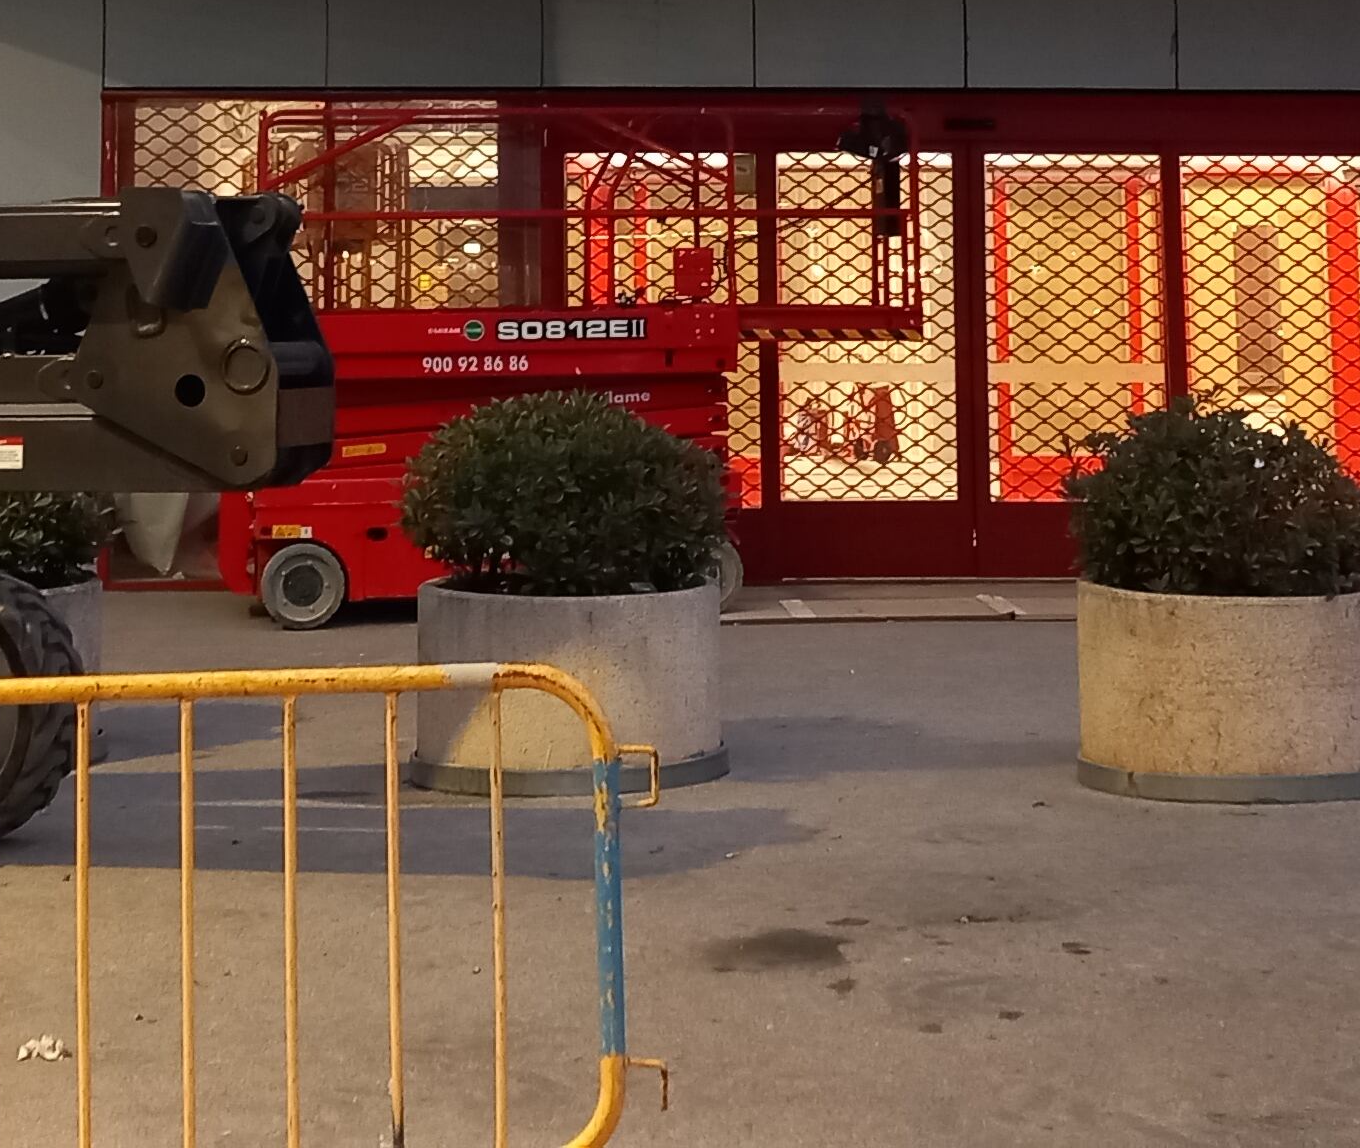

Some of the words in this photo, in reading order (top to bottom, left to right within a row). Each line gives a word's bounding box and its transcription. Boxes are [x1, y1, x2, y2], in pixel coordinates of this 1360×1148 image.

[422, 356, 453, 373] 900
[457, 356, 478, 372] 92
[483, 355, 503, 372] 86
[509, 355, 529, 371] 86
